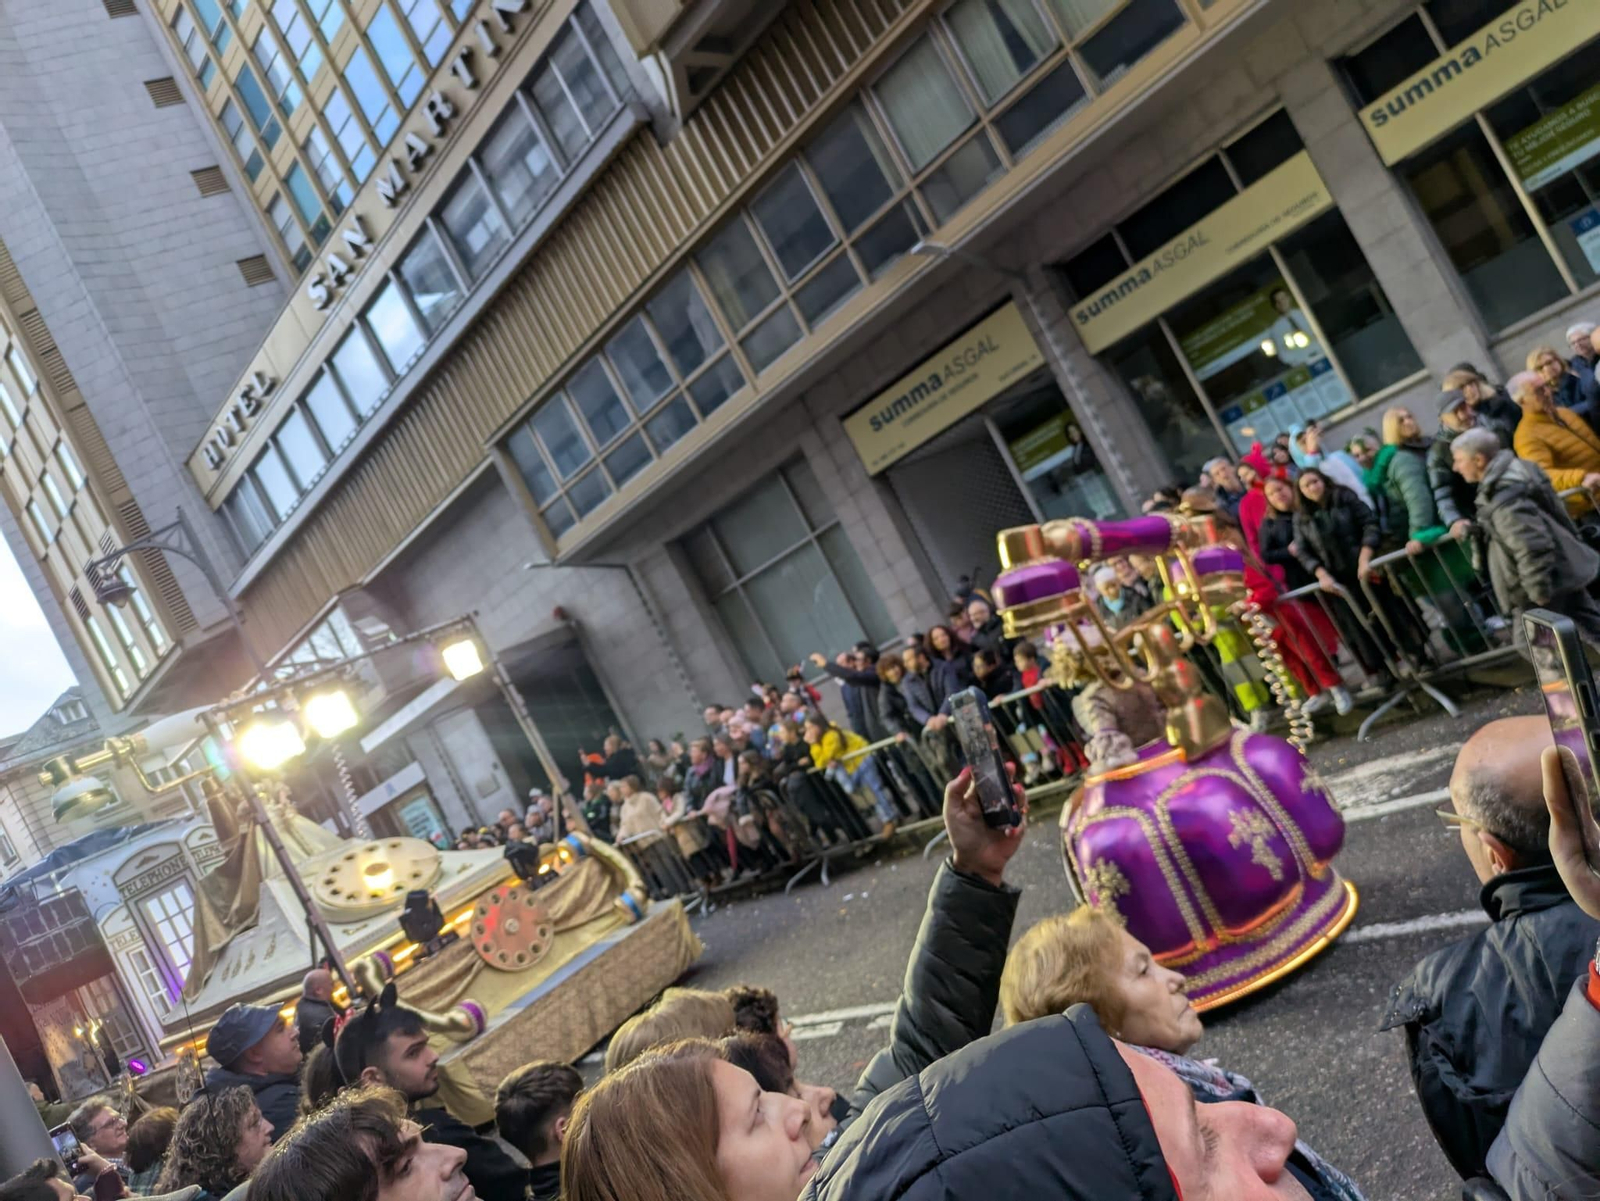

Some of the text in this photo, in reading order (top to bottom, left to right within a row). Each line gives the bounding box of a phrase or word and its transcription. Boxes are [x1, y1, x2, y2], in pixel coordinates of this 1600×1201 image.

[201, 0, 531, 471] HOTEL SAN MARTIN
[120, 854, 188, 898] TELEPHONE
